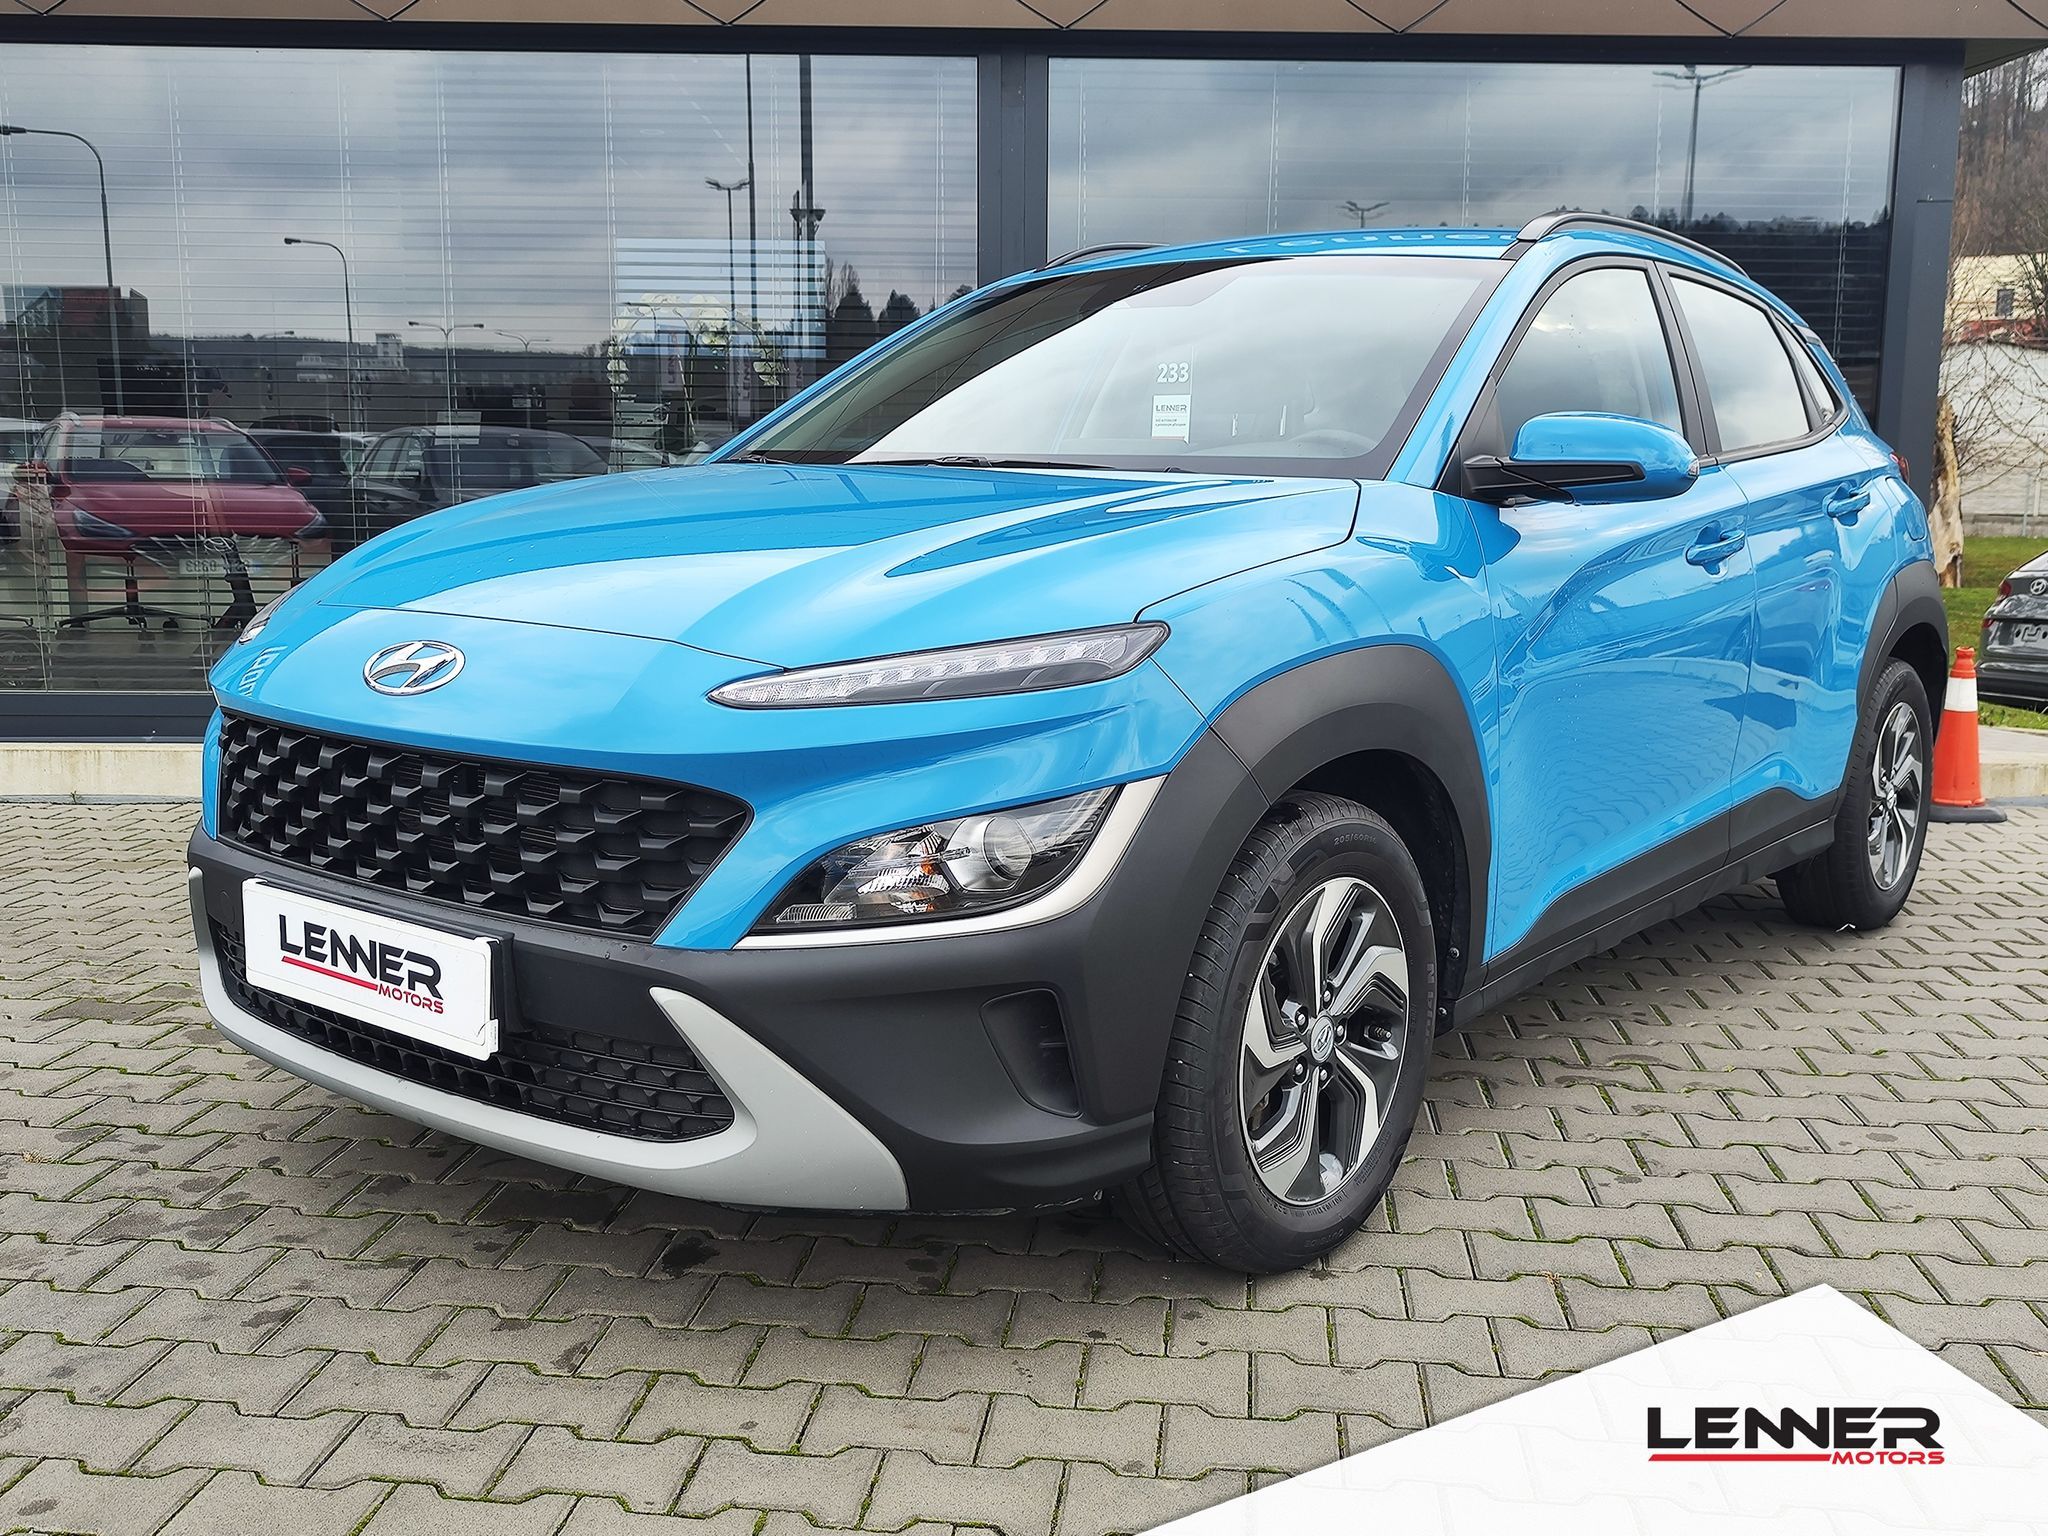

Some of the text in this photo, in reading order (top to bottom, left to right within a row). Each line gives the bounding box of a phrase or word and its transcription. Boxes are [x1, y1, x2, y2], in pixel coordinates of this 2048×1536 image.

[1156, 362, 1189, 383] 233
[1155, 404, 1187, 413] LENNER
[279, 914, 443, 1000] LENNER
[378, 982, 444, 1015] MOTORS
